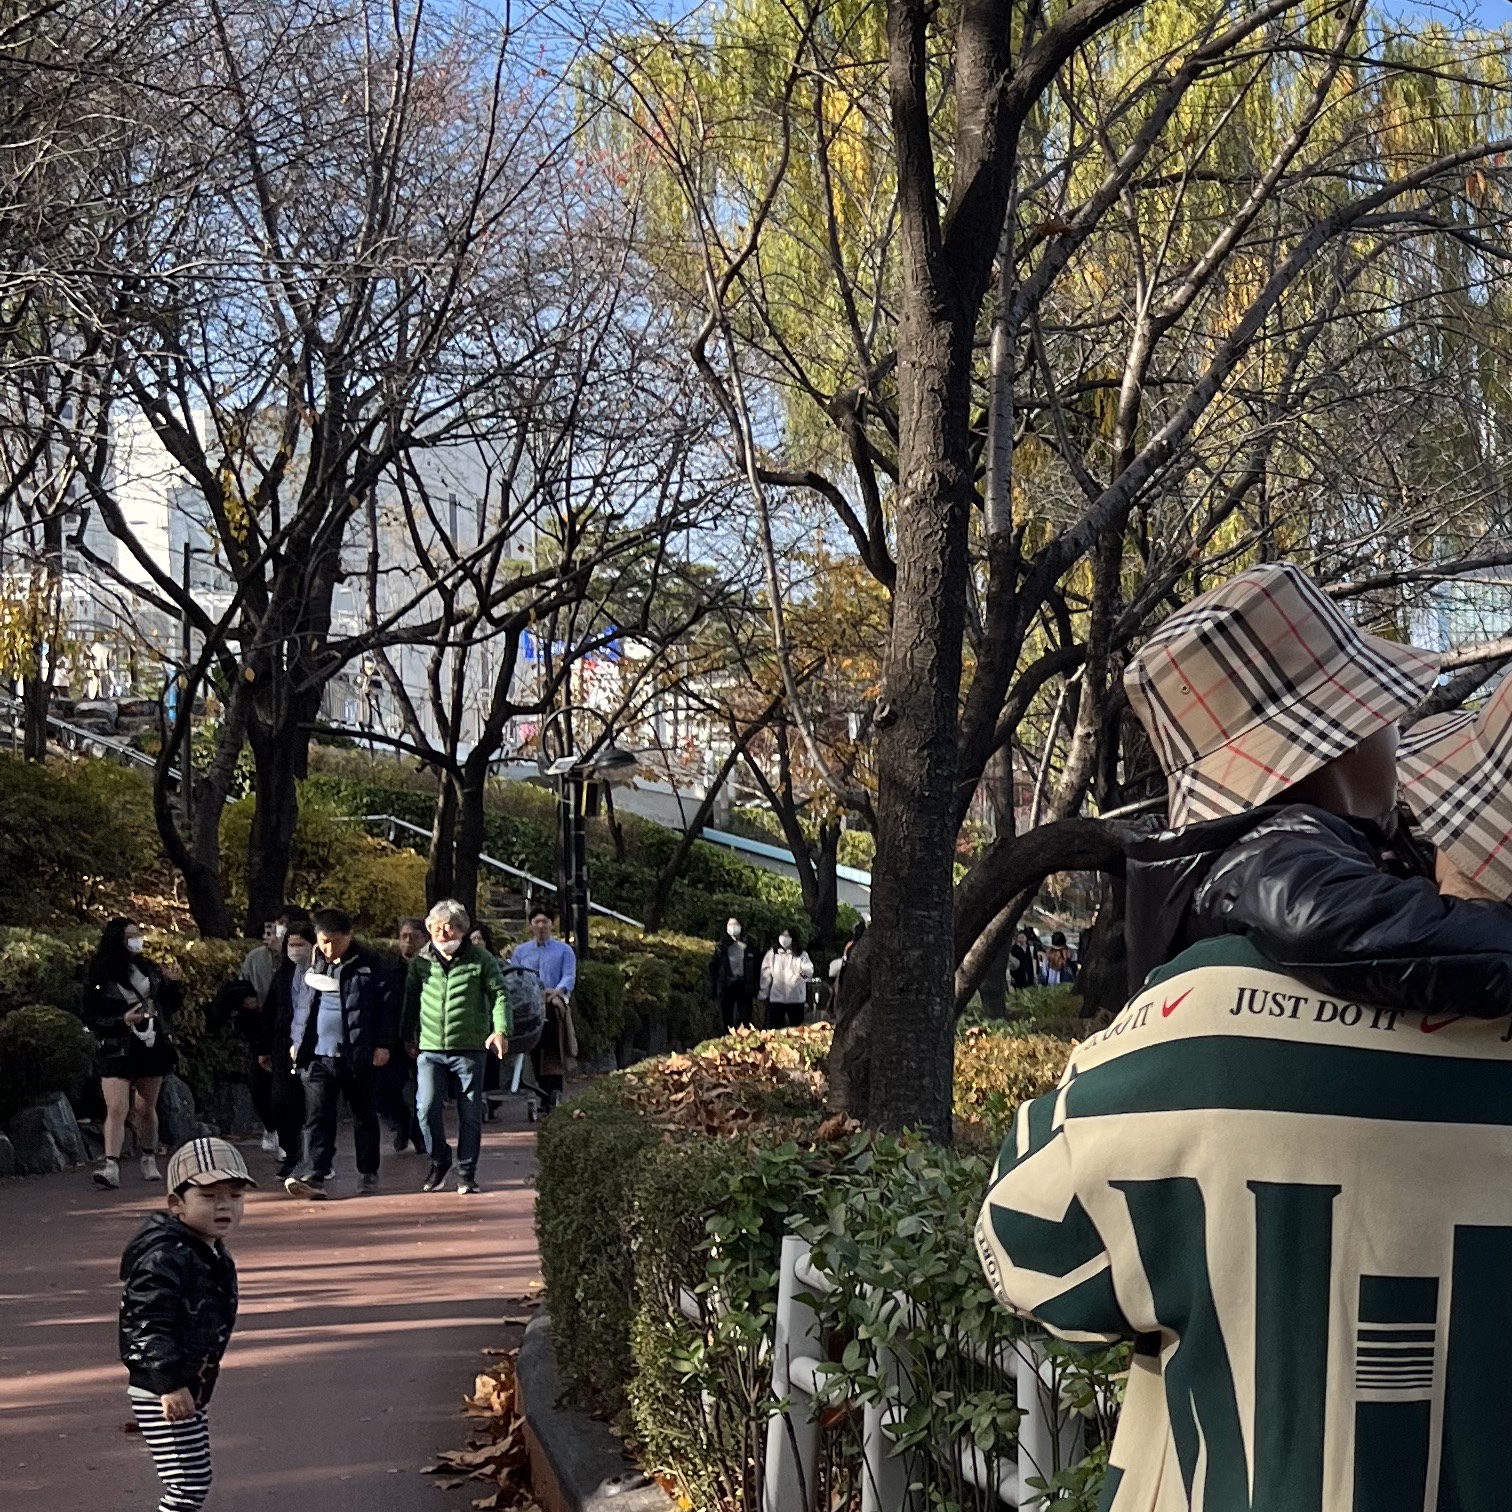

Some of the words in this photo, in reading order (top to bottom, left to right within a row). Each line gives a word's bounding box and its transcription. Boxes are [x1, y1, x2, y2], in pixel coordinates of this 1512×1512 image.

[1131, 1001, 1154, 1030] IT
[1229, 987, 1308, 1019] JUST
[1313, 999, 1363, 1026] DO
[1369, 1007, 1405, 1032] IT
